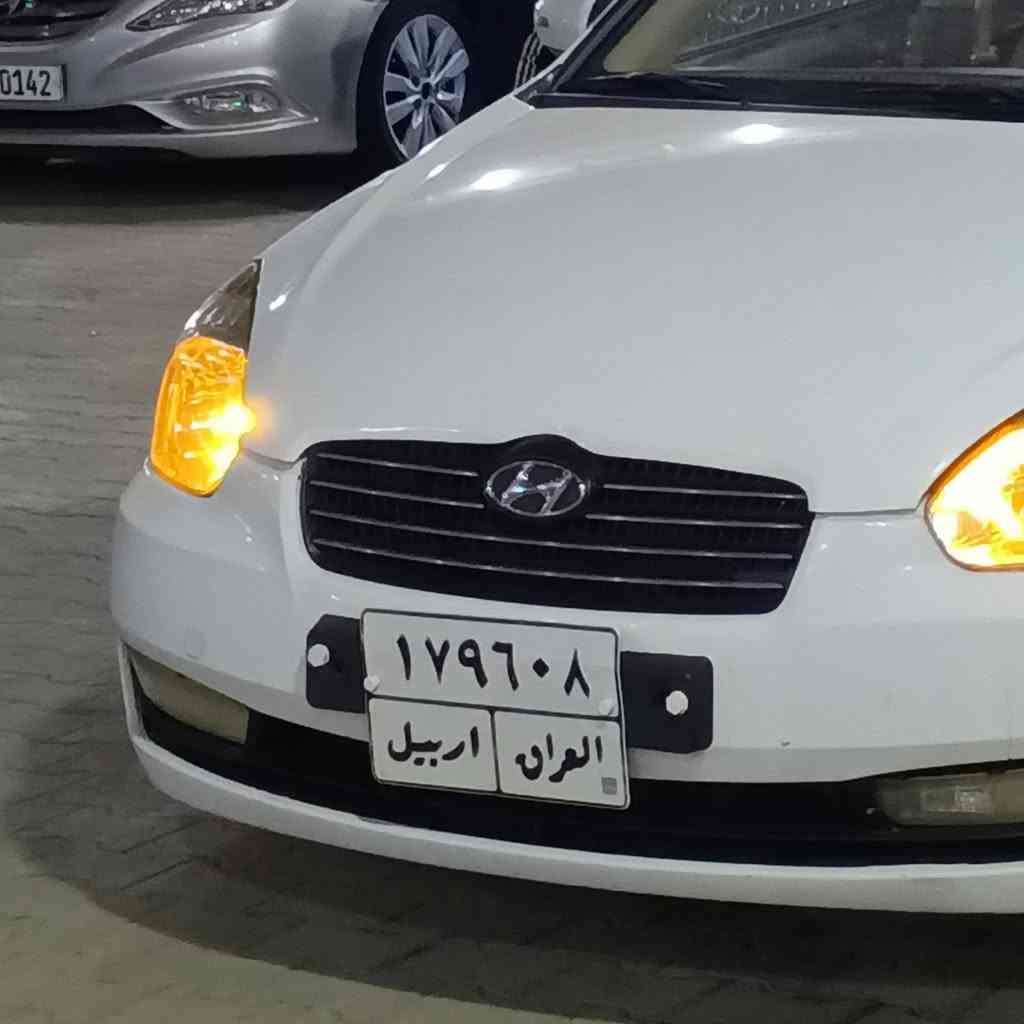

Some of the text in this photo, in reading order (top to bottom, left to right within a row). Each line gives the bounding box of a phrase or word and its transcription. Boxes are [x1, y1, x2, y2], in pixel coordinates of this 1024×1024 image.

[0, 69, 52, 97] 0142
[396, 634, 591, 700] ١٧٩٦٠٨
[388, 721, 603, 783] العراق اربيل
